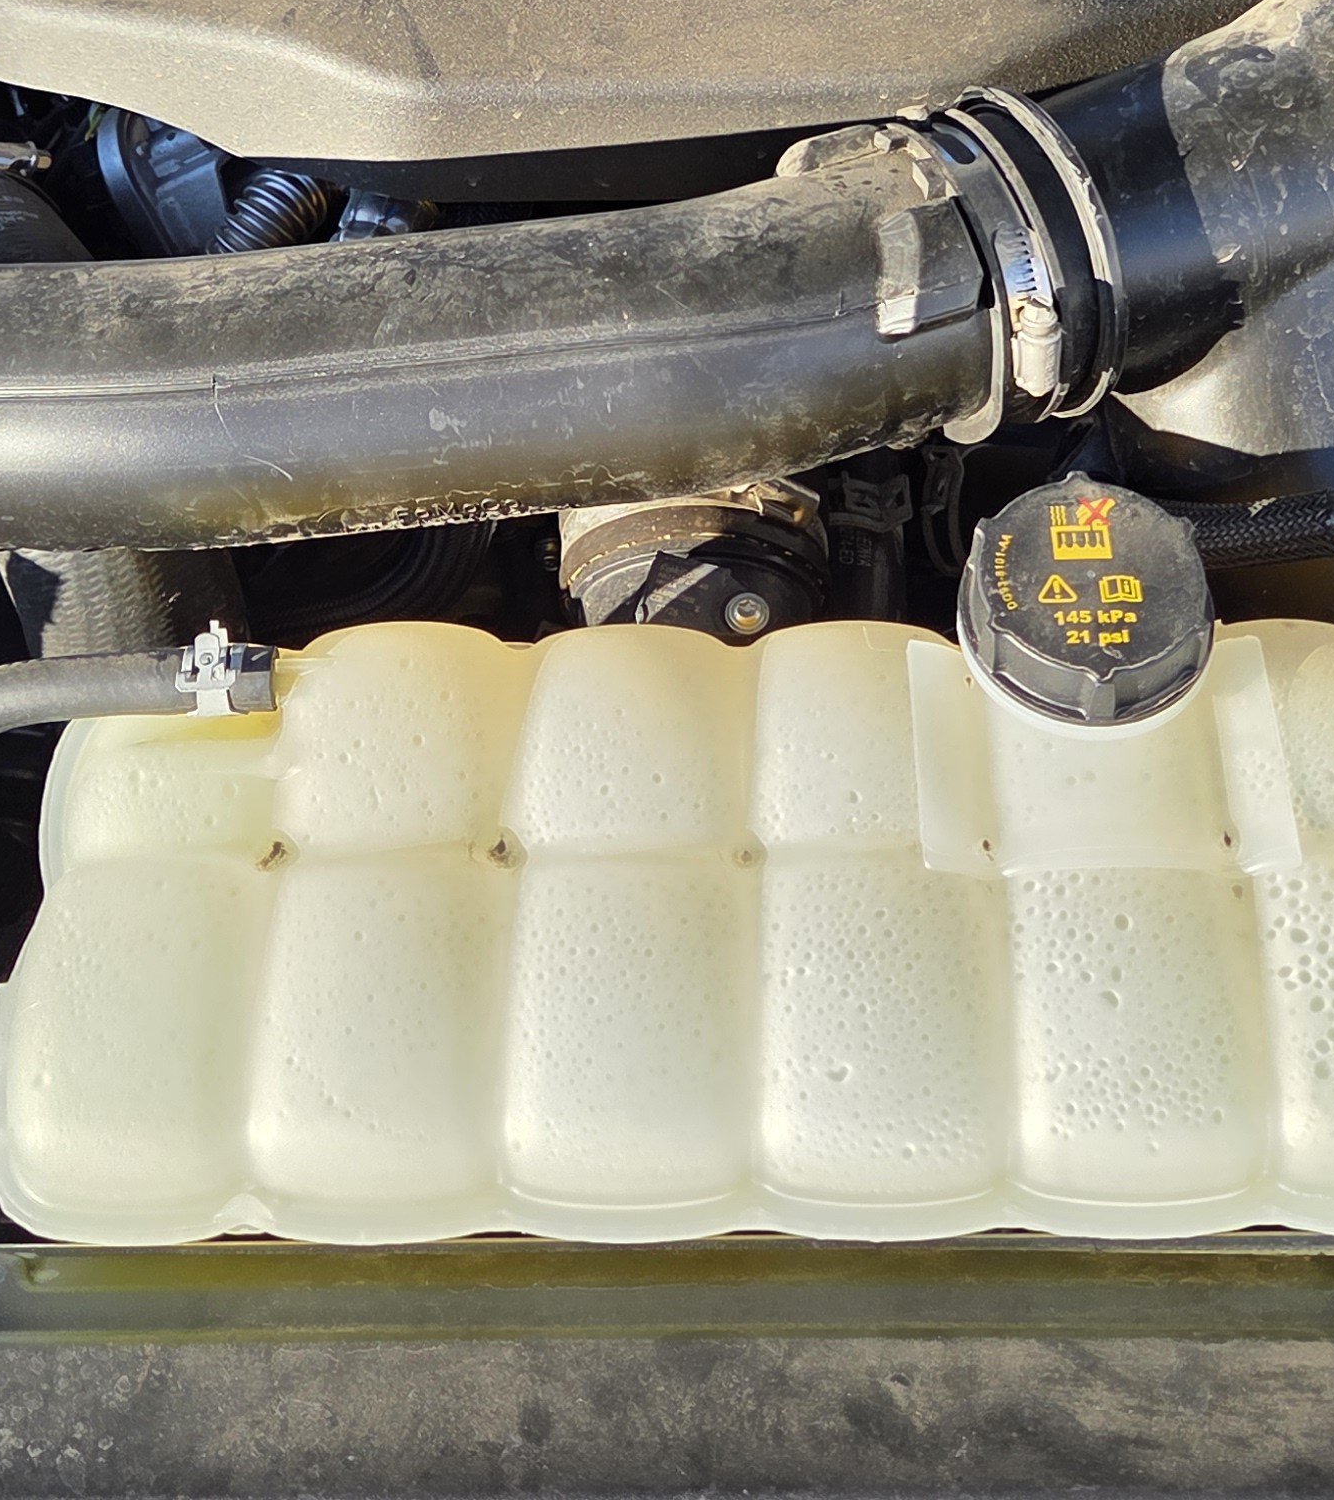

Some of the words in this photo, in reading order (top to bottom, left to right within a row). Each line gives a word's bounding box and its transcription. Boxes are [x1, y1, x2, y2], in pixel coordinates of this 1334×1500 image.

[1054, 610, 1092, 624] 145
[1097, 610, 1137, 624] kPa
[1066, 631, 1091, 644] 21
[1098, 630, 1130, 646] psi
